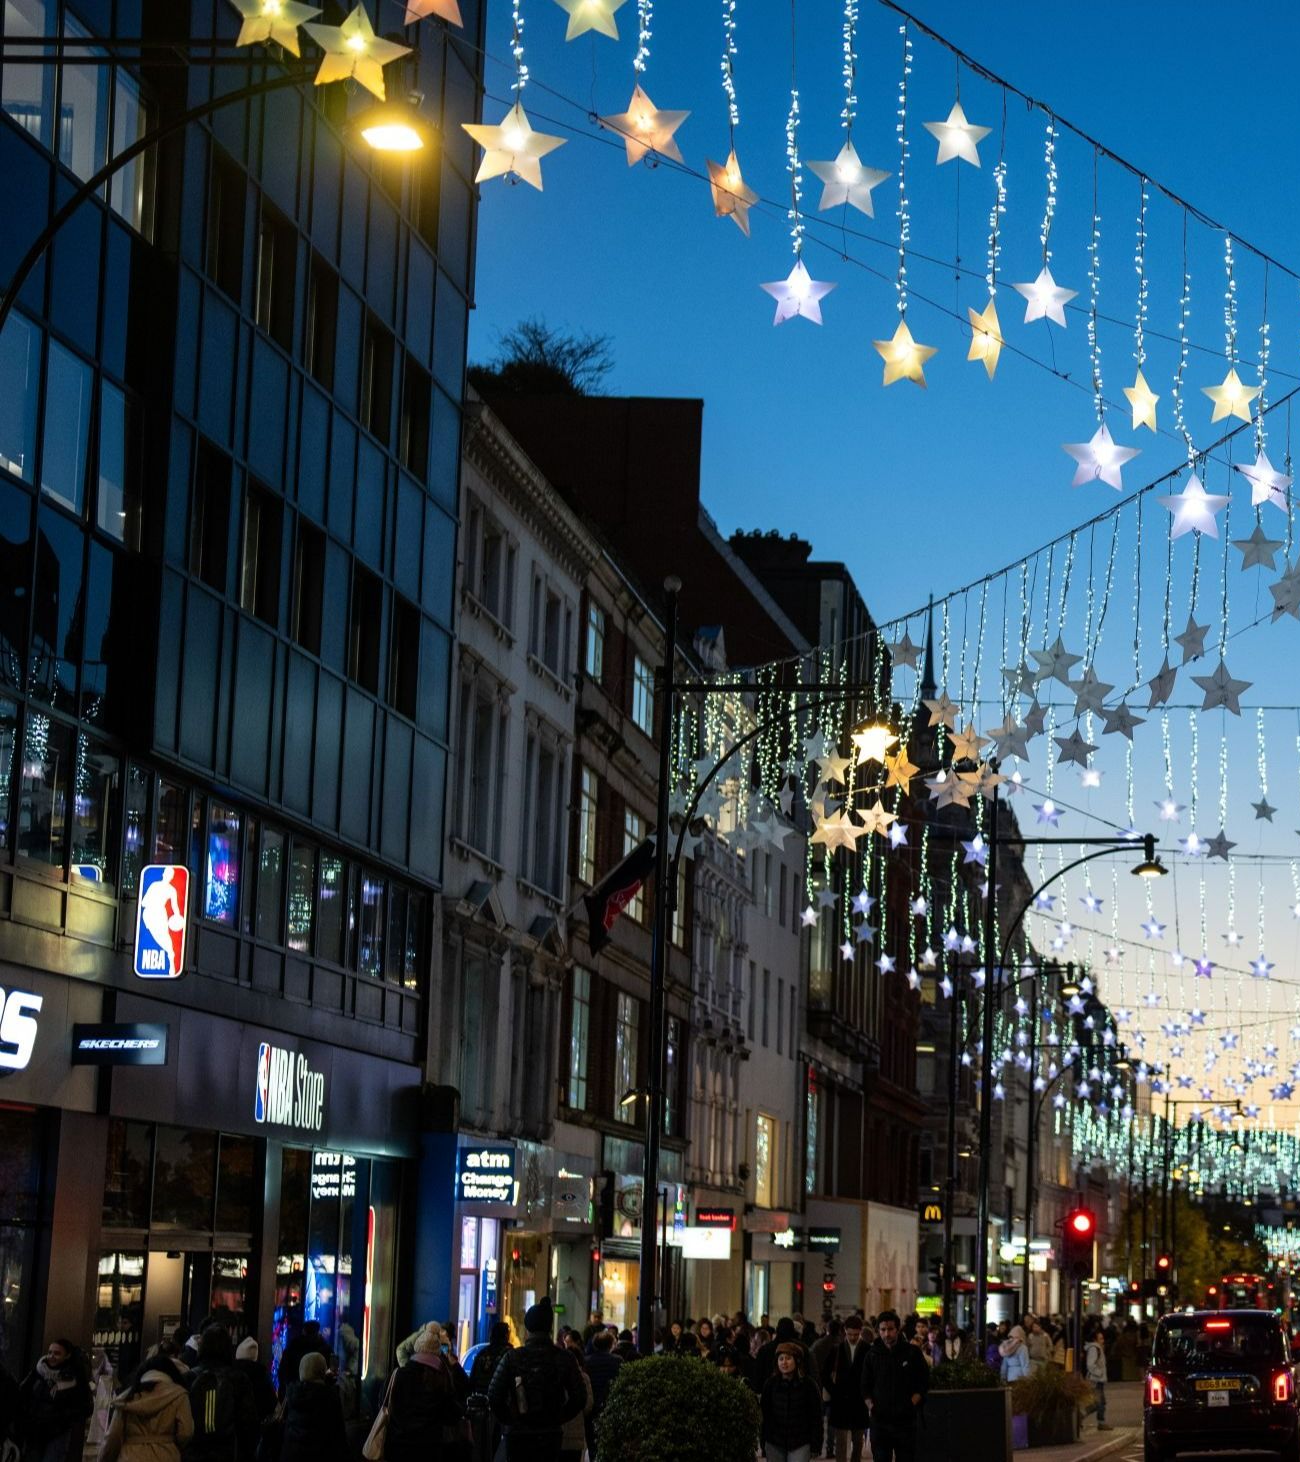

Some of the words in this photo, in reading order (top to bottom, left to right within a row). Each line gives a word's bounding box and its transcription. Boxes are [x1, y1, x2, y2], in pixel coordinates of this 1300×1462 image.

[142, 949, 166, 970] NBA
[79, 1039, 160, 1049] SKECHERS
[267, 1046, 295, 1126] NBA
[294, 1053, 324, 1131] Store
[466, 1150, 510, 1168] atm
[461, 1172, 513, 1187] Change
[463, 1185, 509, 1200] Money
